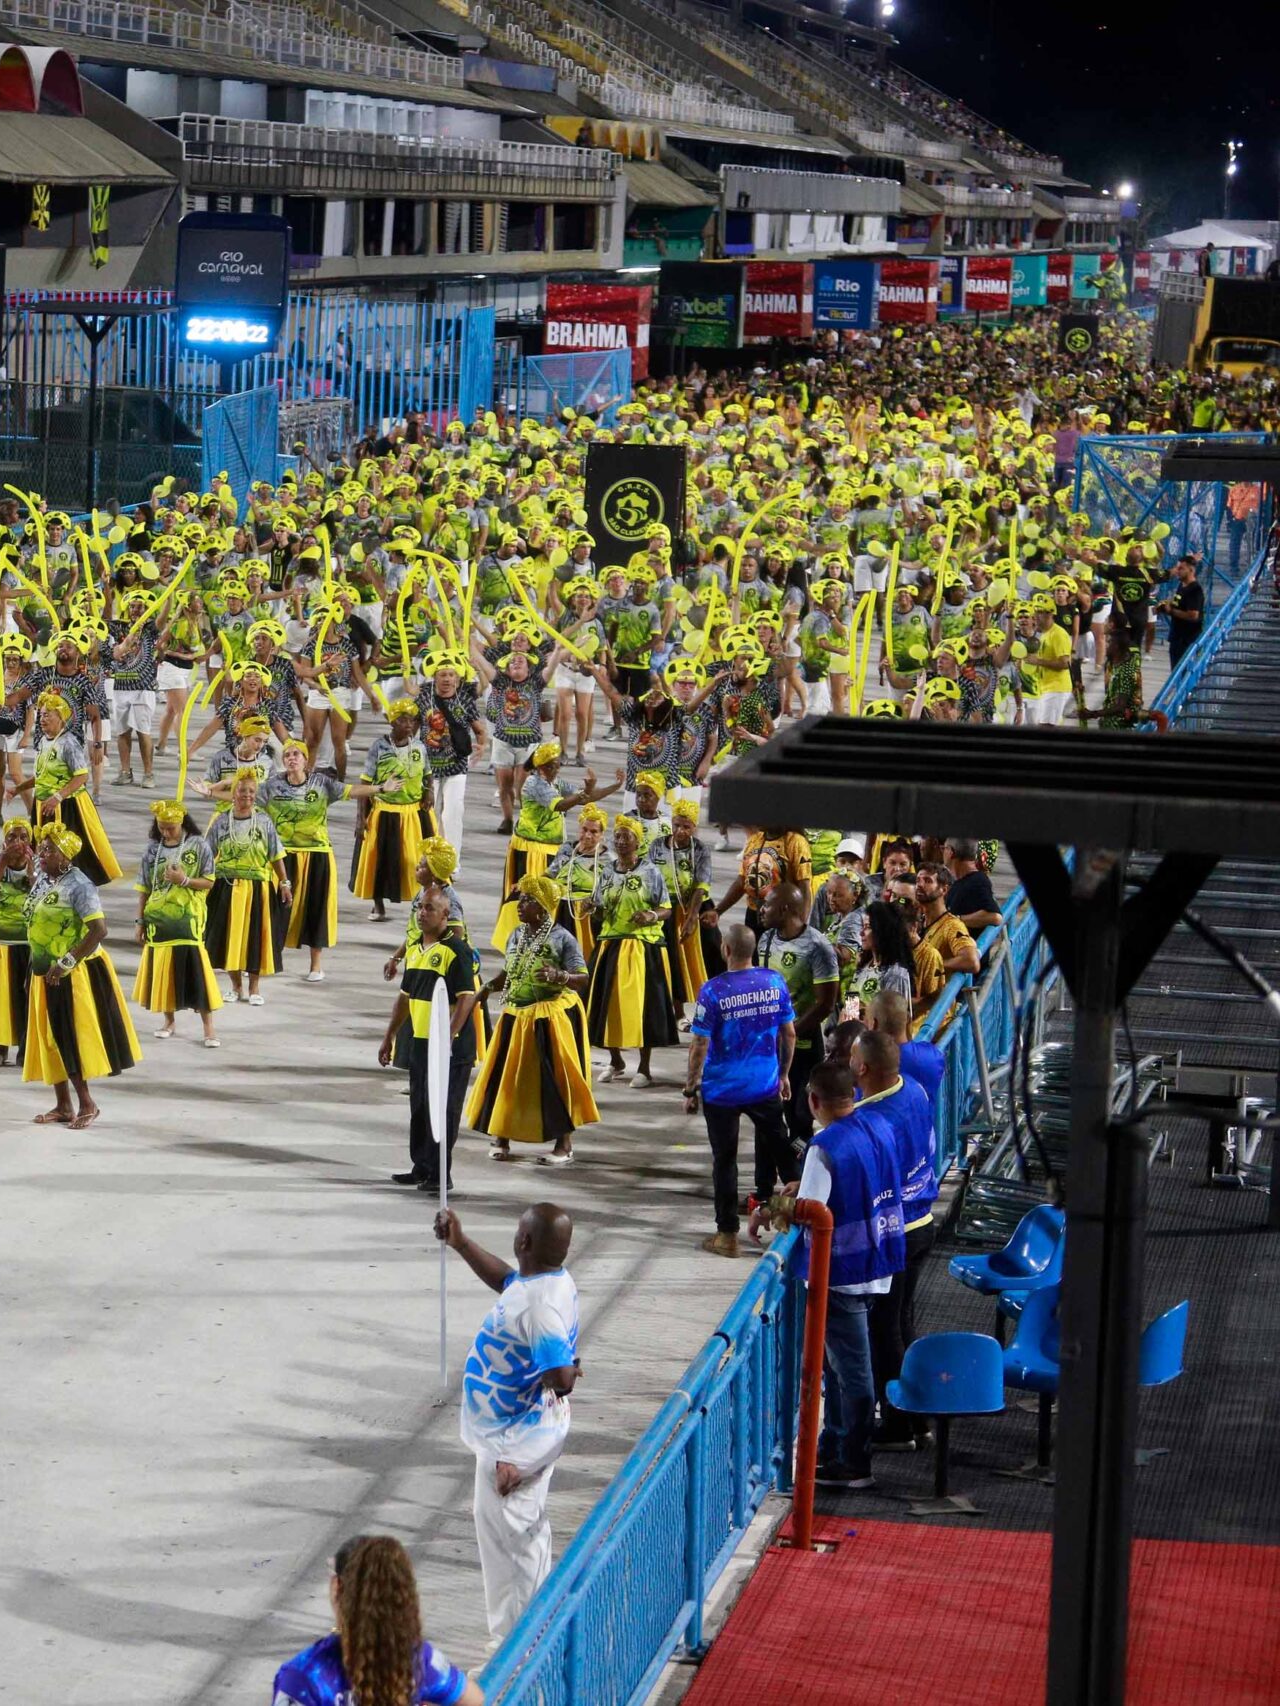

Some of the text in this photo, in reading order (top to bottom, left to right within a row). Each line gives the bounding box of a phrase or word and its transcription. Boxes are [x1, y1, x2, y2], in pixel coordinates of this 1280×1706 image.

[835, 278, 860, 292] Rio
[879, 285, 925, 304] RAHMA
[966, 278, 1008, 294] RAHMA
[743, 293, 798, 314] RAHMA
[546, 321, 629, 349] BRAHMA
[719, 986, 780, 1011] COORDENAÇÃO
